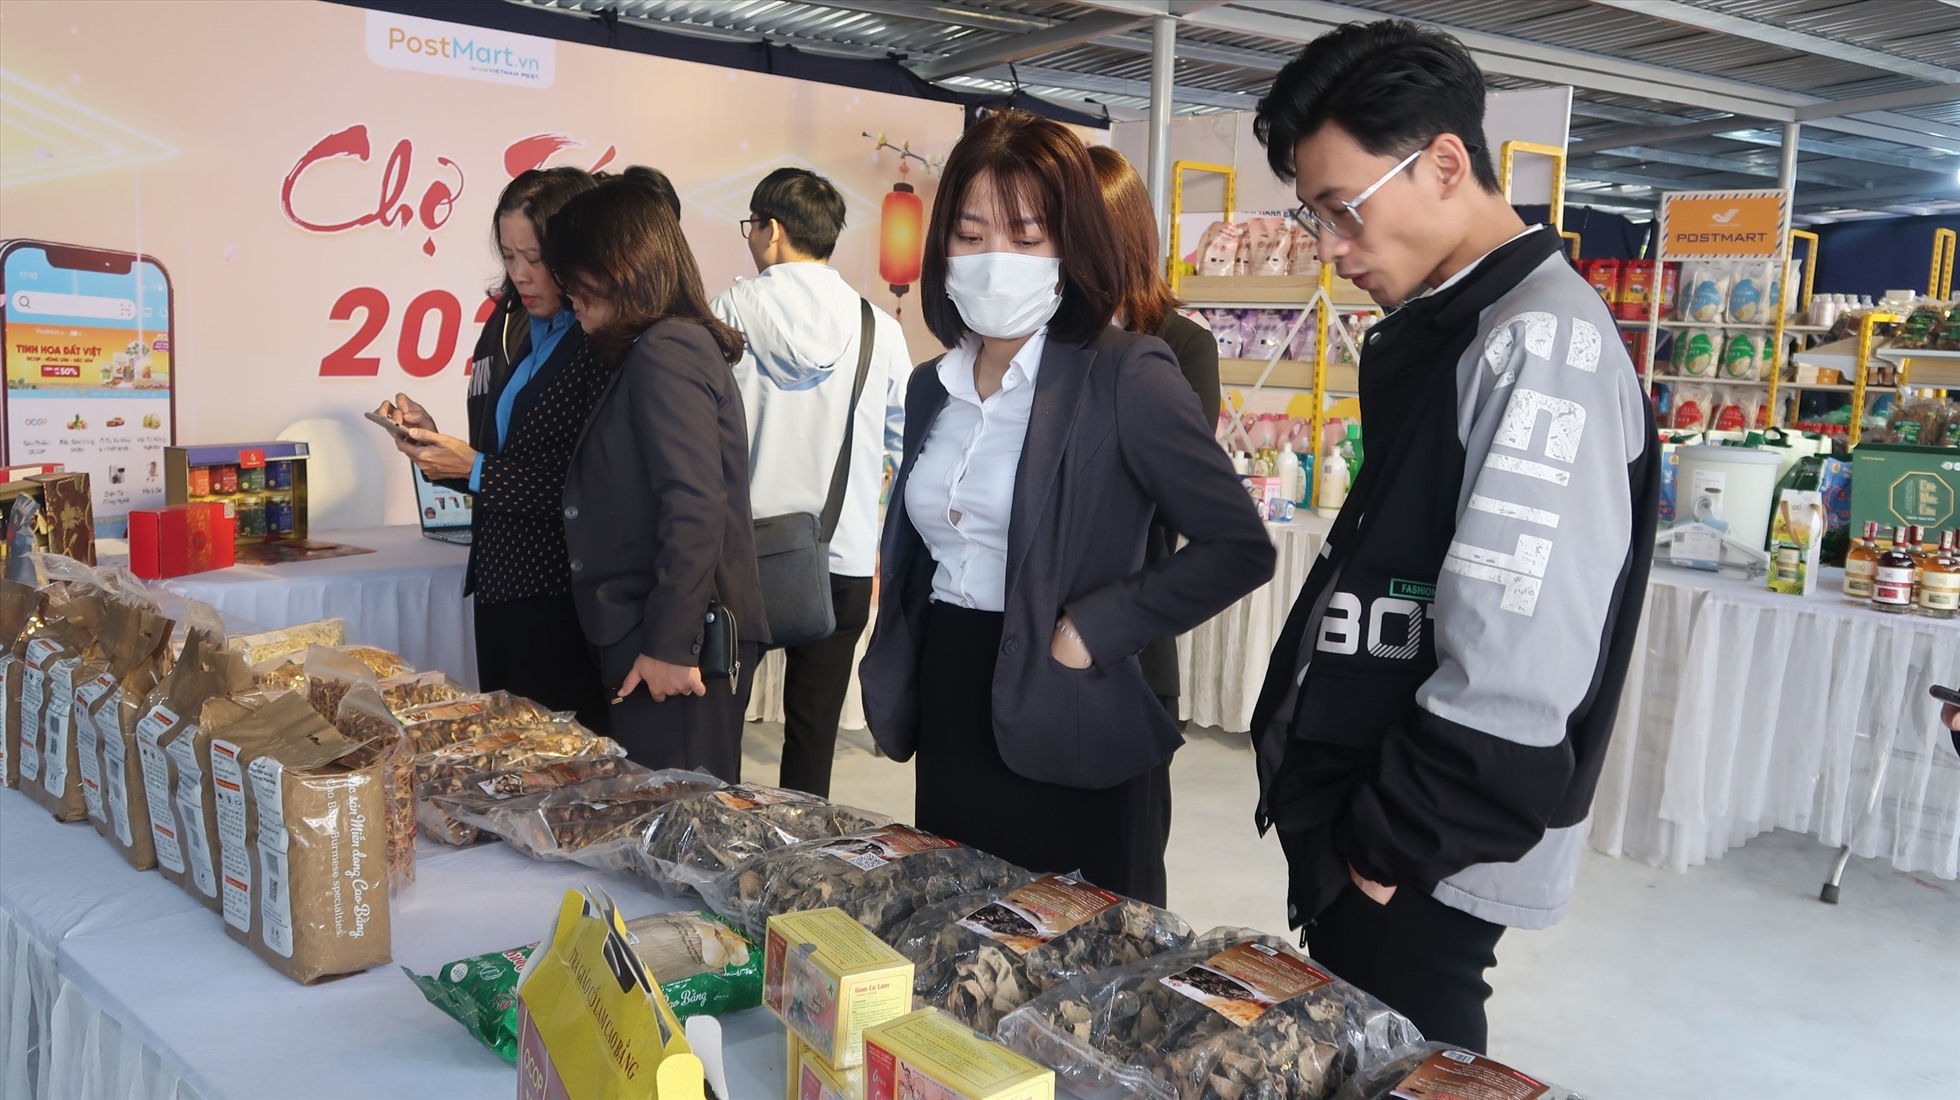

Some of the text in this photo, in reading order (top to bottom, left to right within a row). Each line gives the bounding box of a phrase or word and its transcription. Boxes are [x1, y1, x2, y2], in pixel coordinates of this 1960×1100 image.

[388, 27, 540, 71] PostMart.vn
[488, 68, 519, 76] VIETNAM
[281, 124, 464, 257] Chợ
[1677, 232, 1768, 243] POSTMART
[16, 344, 38, 355] TINH
[41, 345, 61, 355] HOA
[83, 346, 102, 357] VIỆT
[1316, 591, 1435, 660] BO
[329, 831, 340, 878] Burmese
[331, 880, 345, 937] specialties
[351, 878, 369, 905] Cao
[349, 903, 370, 939] Bằng
[664, 988, 708, 1009] ao Bằng
[592, 998, 609, 1030] LAM
[603, 1019, 620, 1050] CAO
[523, 1048, 544, 1093] OCOP
